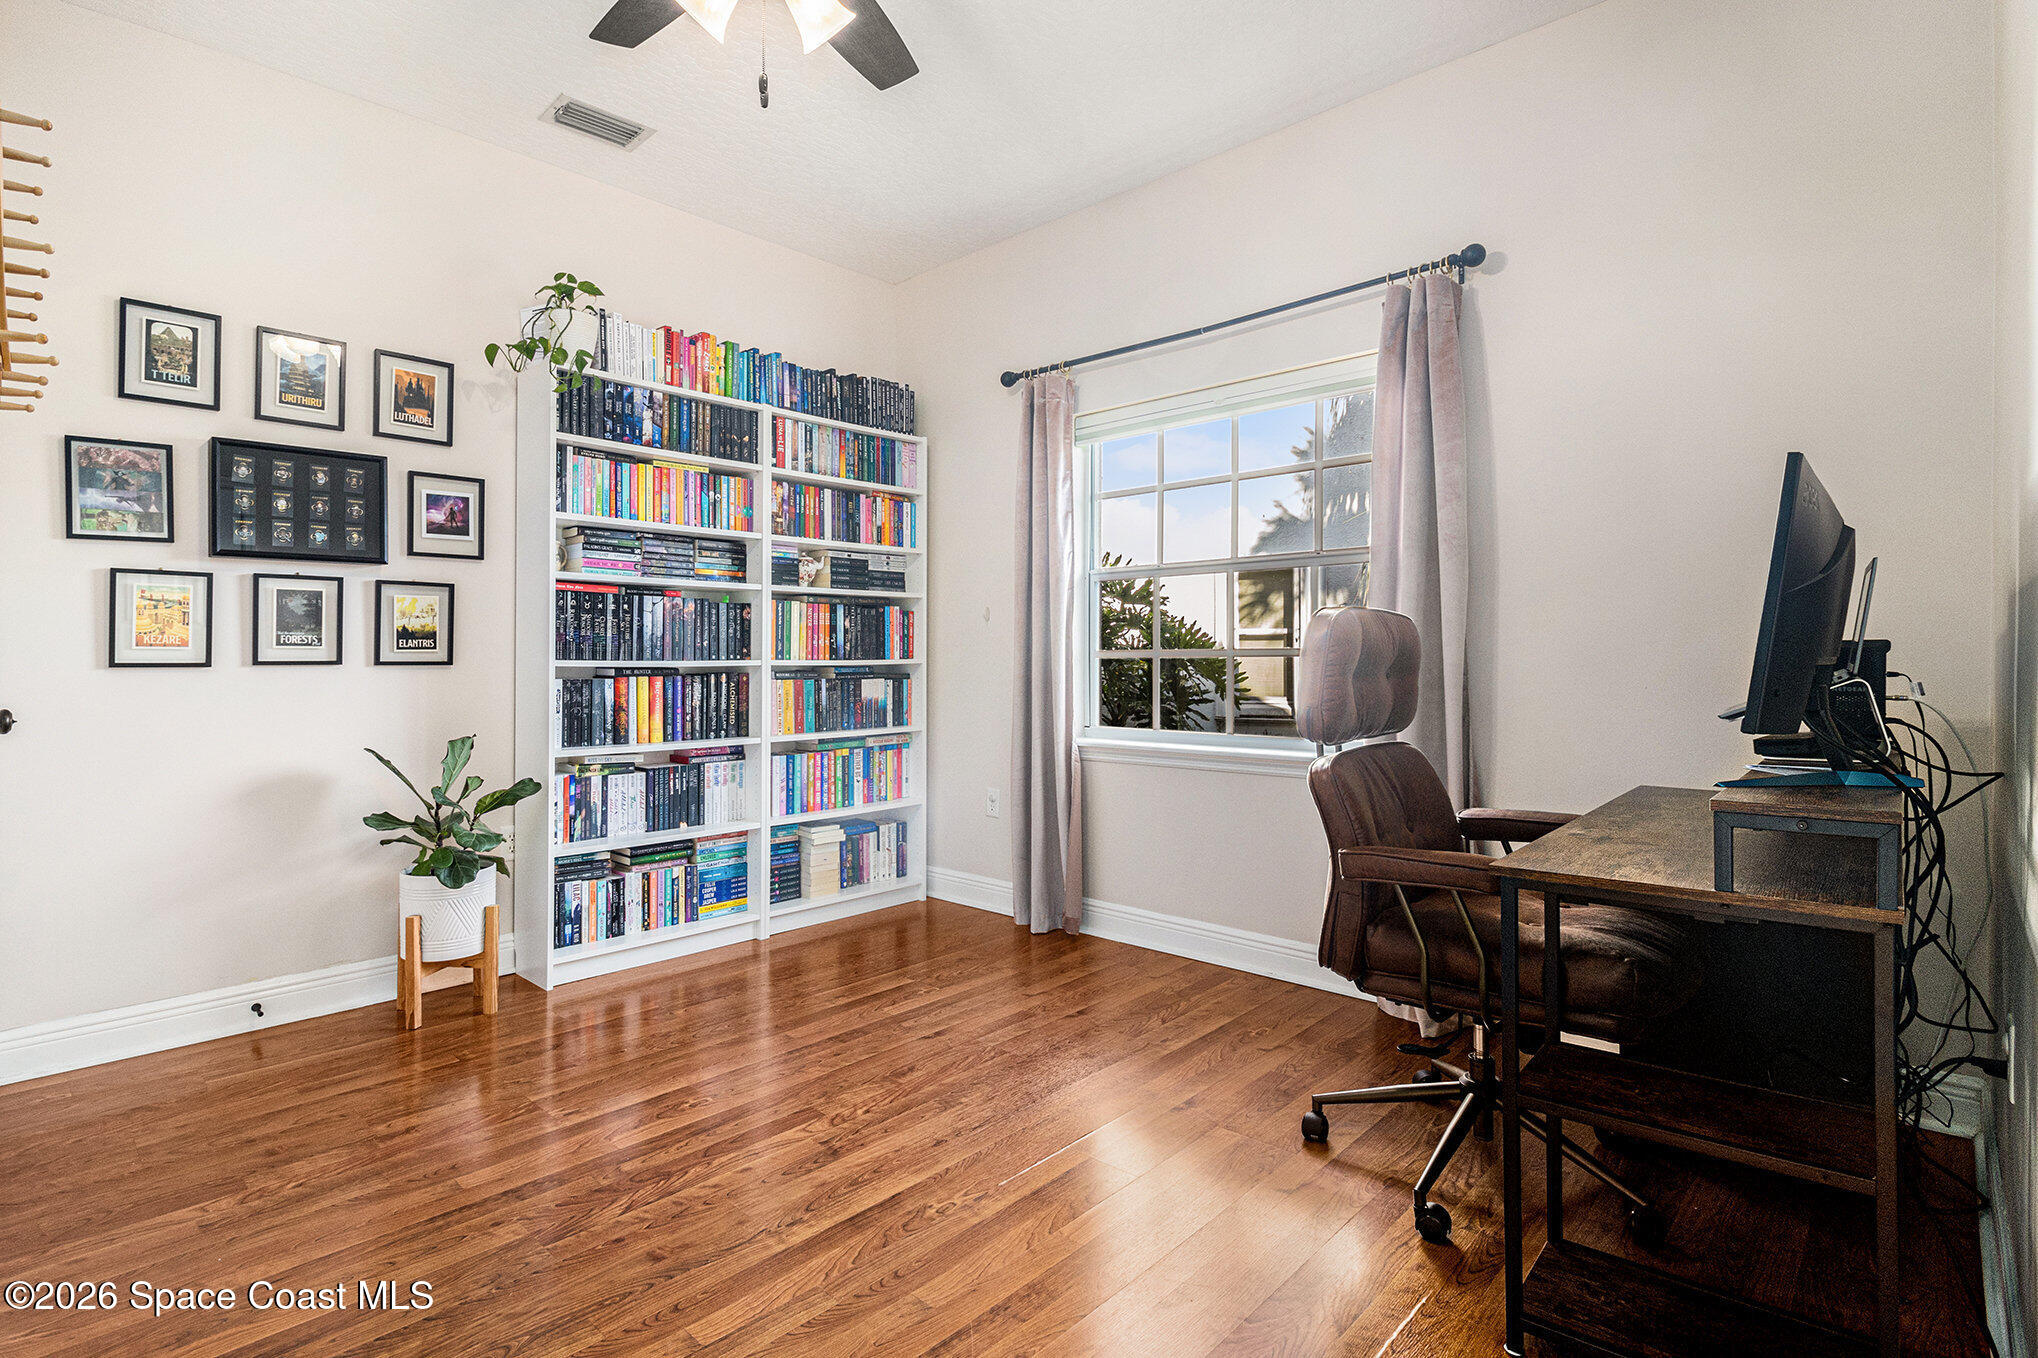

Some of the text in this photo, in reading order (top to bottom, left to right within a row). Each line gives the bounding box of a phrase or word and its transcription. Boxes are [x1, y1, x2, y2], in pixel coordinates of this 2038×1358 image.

[282, 392, 323, 408] URITHIRU
[394, 411, 433, 426] LUTHADEL
[143, 635, 182, 645] KEZARE
[280, 635, 318, 644] FORESTS
[399, 639, 434, 648] ELANTRIS
